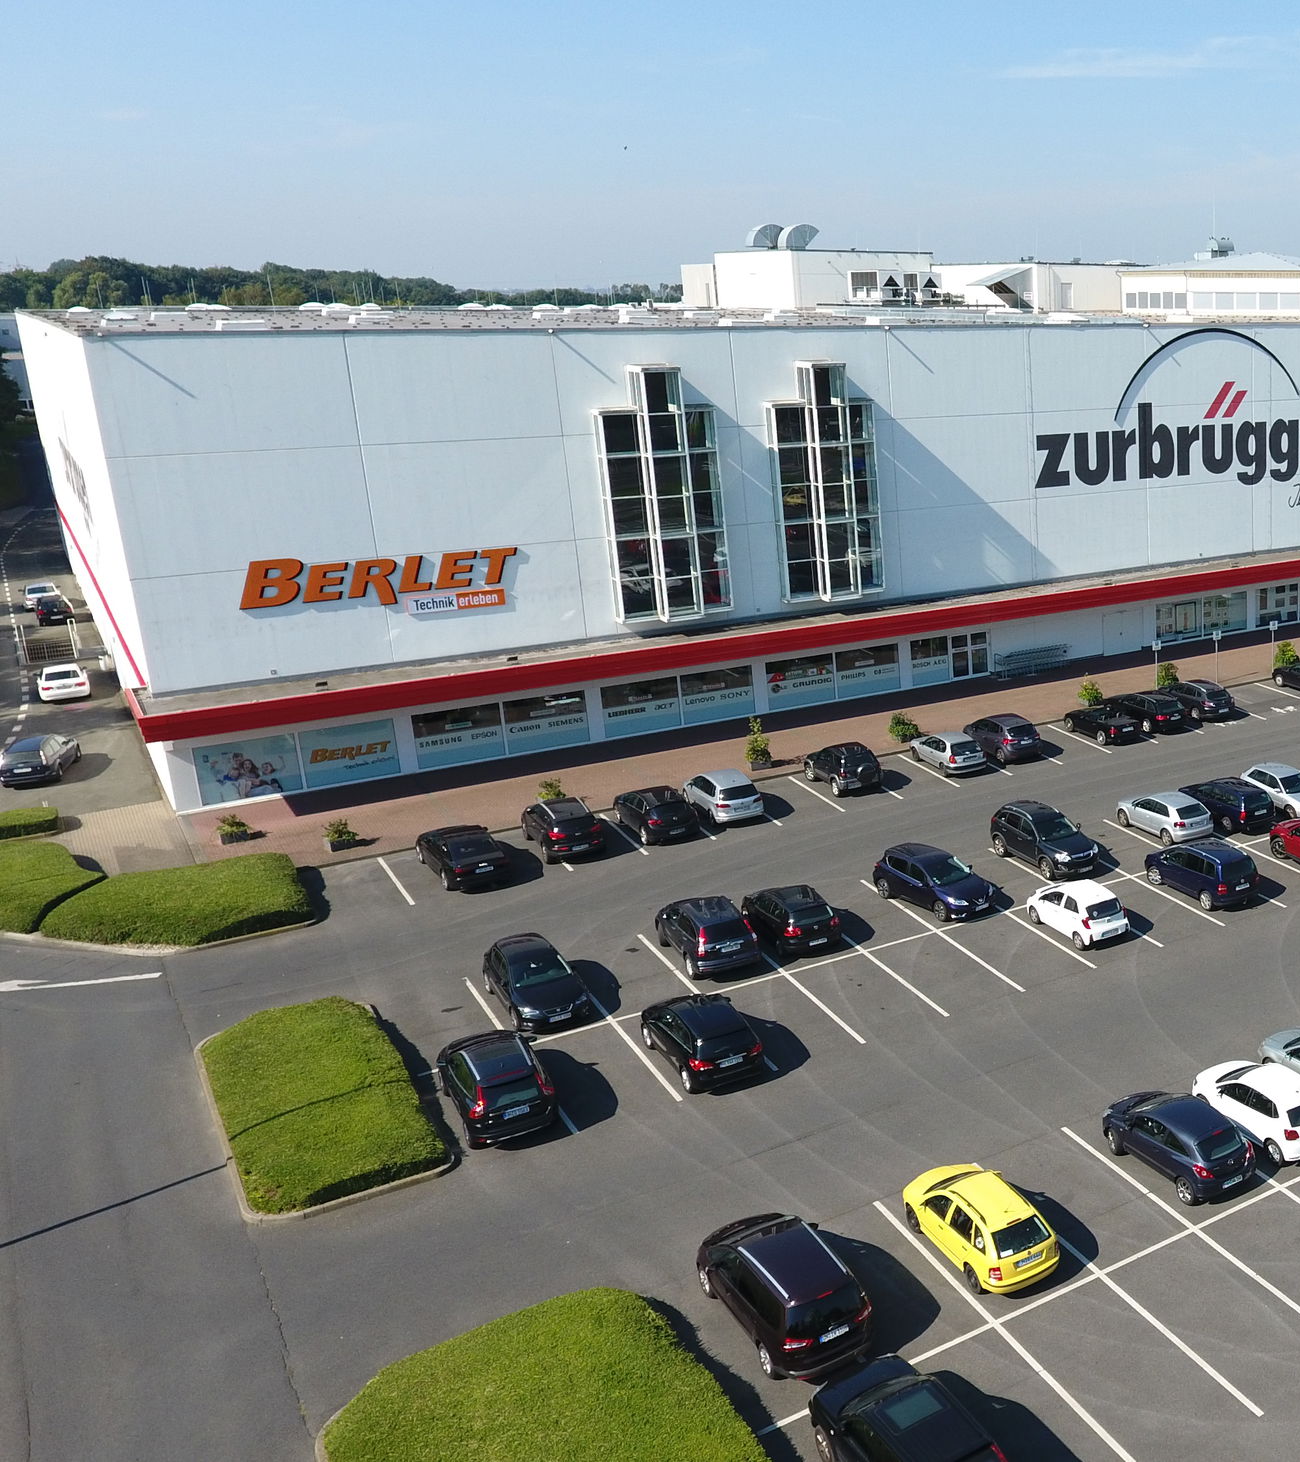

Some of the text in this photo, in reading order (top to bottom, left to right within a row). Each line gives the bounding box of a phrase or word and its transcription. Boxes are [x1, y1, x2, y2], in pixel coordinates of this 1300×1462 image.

[239, 547, 518, 611] BERLET
[413, 592, 499, 611] Technik erleben
[912, 661, 931, 669] BOSCH
[792, 677, 832, 688] GRUNDIG
[840, 671, 866, 681] PHILIPS
[685, 690, 750, 706] Lenovo SONY
[607, 706, 647, 718] LIEBHERR
[509, 717, 584, 734] Canon SIEMENS
[419, 730, 498, 749] SAMSUNG EPSON
[309, 740, 391, 764] BERLET
